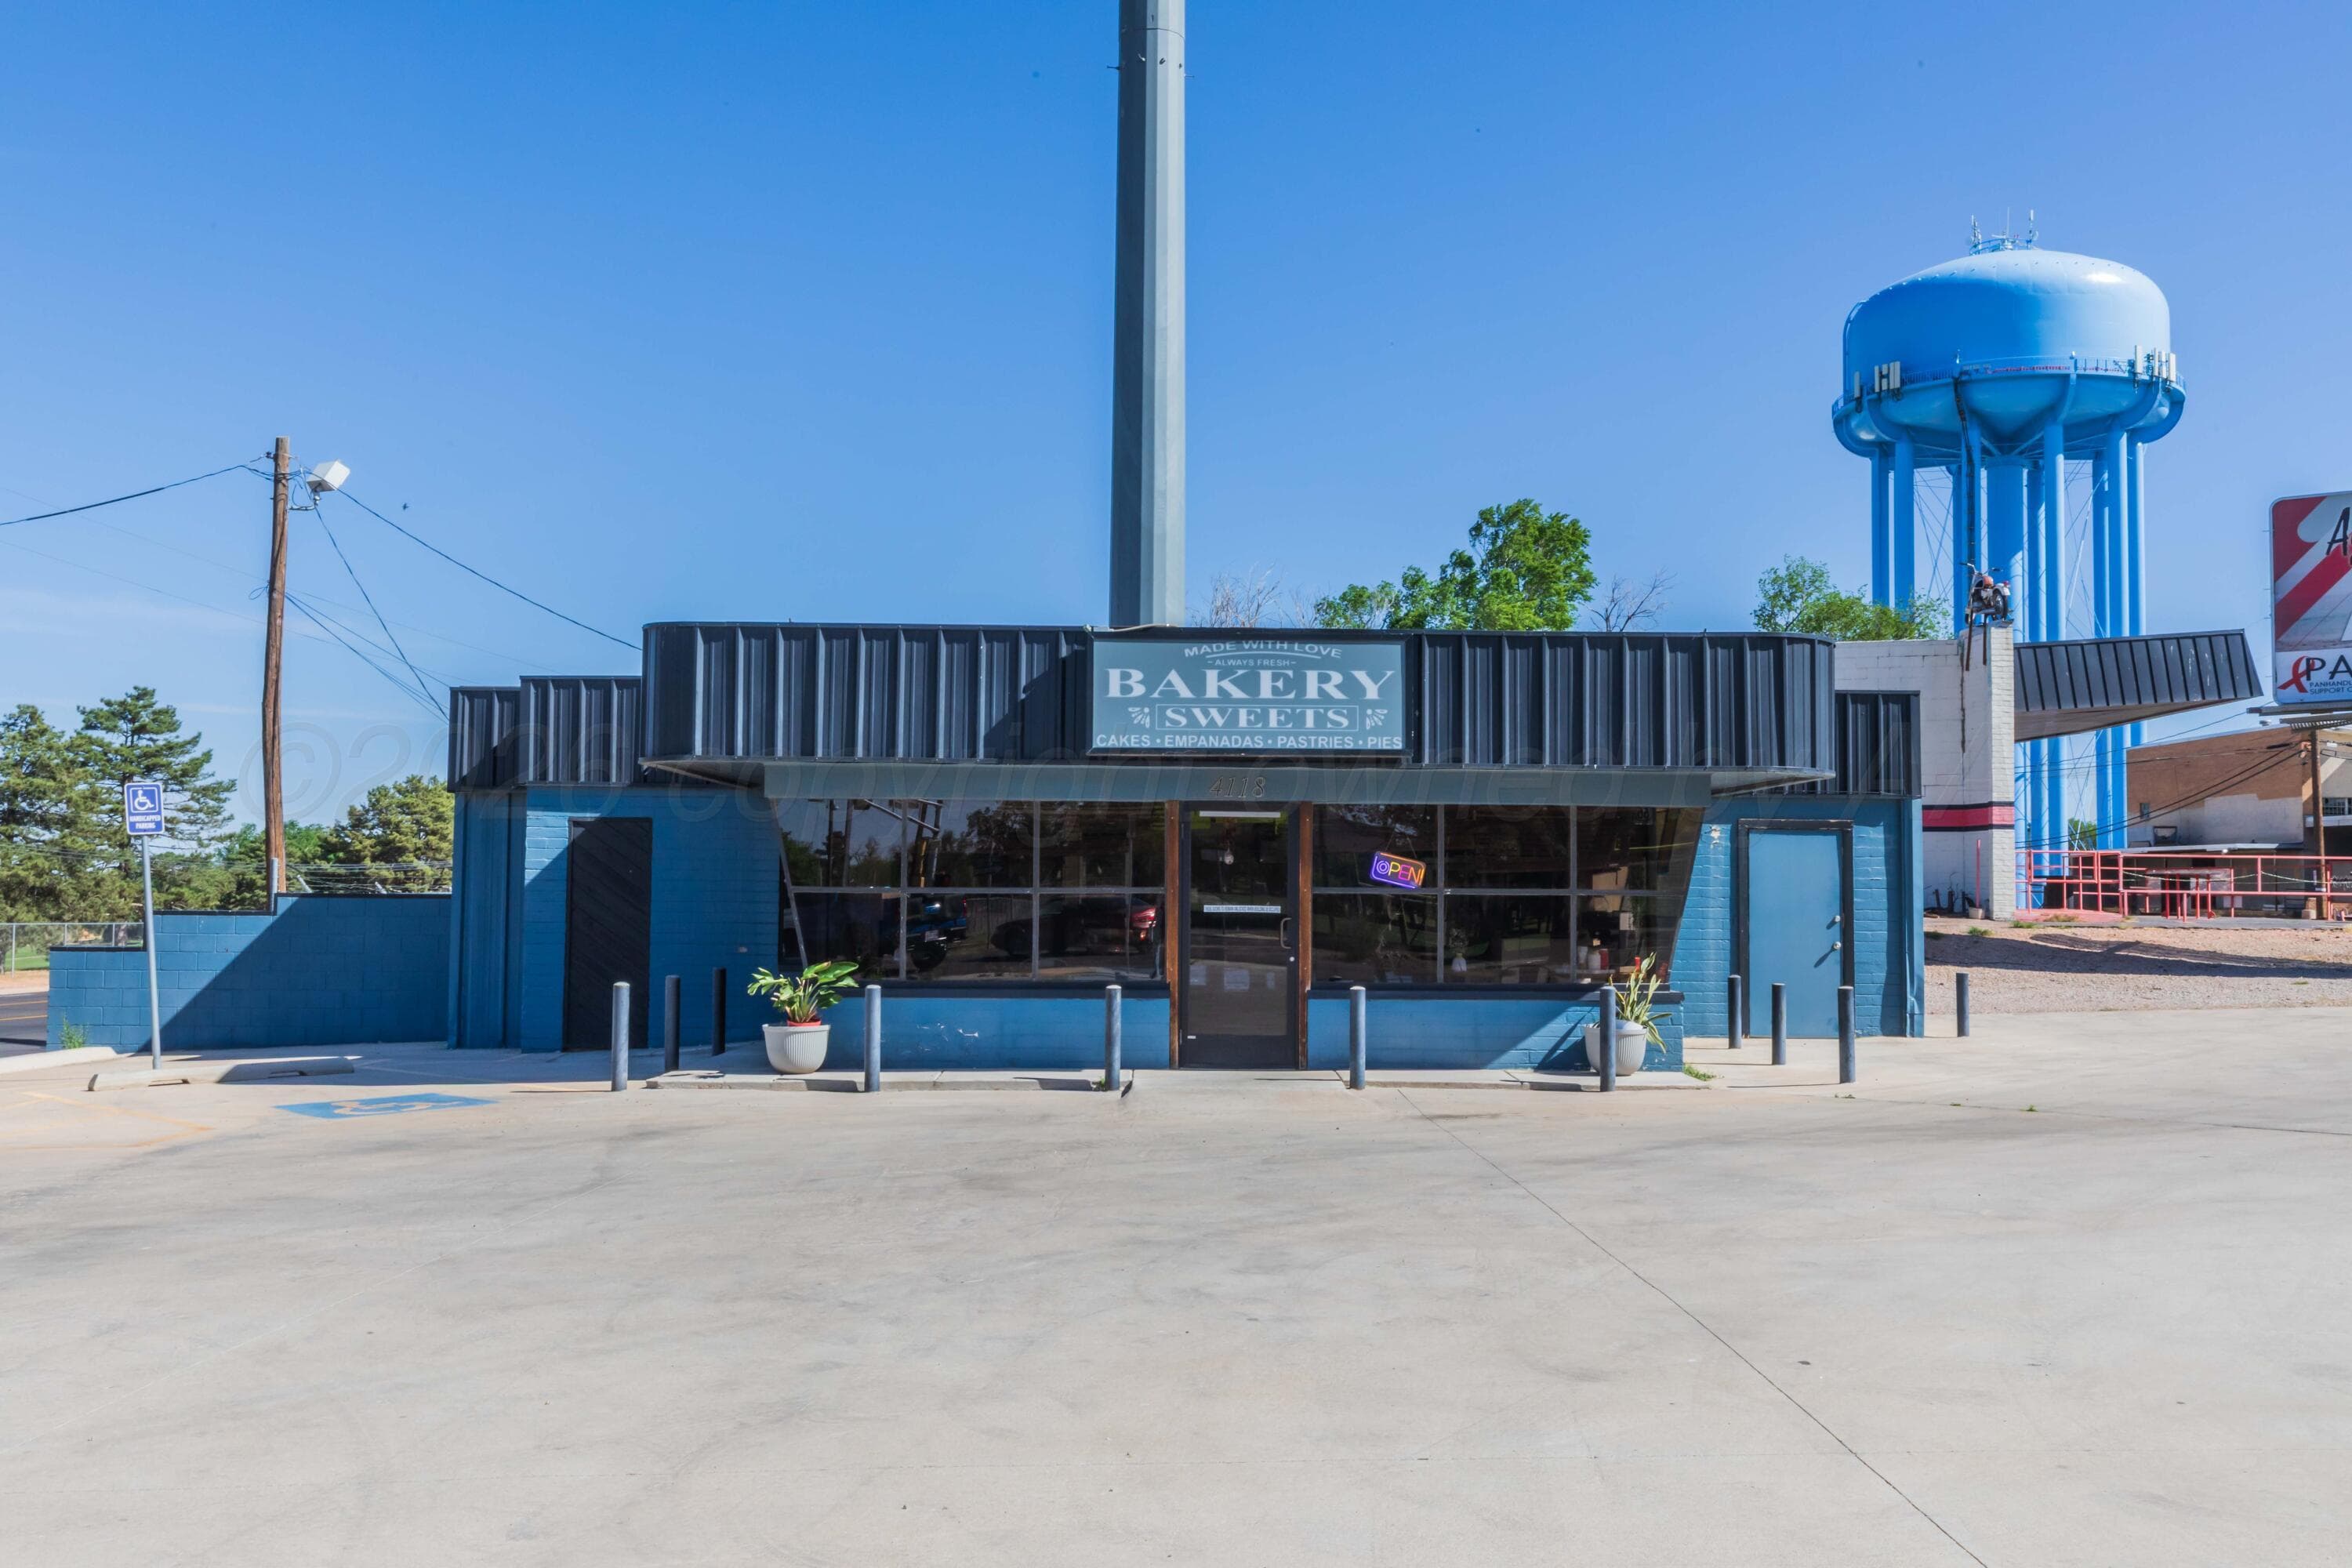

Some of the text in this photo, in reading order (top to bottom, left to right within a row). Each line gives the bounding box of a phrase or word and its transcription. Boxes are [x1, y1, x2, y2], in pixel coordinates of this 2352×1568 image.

[1184, 640, 1343, 659] MADE WITH LOVE
[1105, 668, 1396, 700] BAKERY
[1165, 706, 1349, 729] SWEETS
[1096, 734, 1403, 749] CAKES EMPANADAS PASTRIES PIES
[1376, 861, 1421, 884] OPEN
